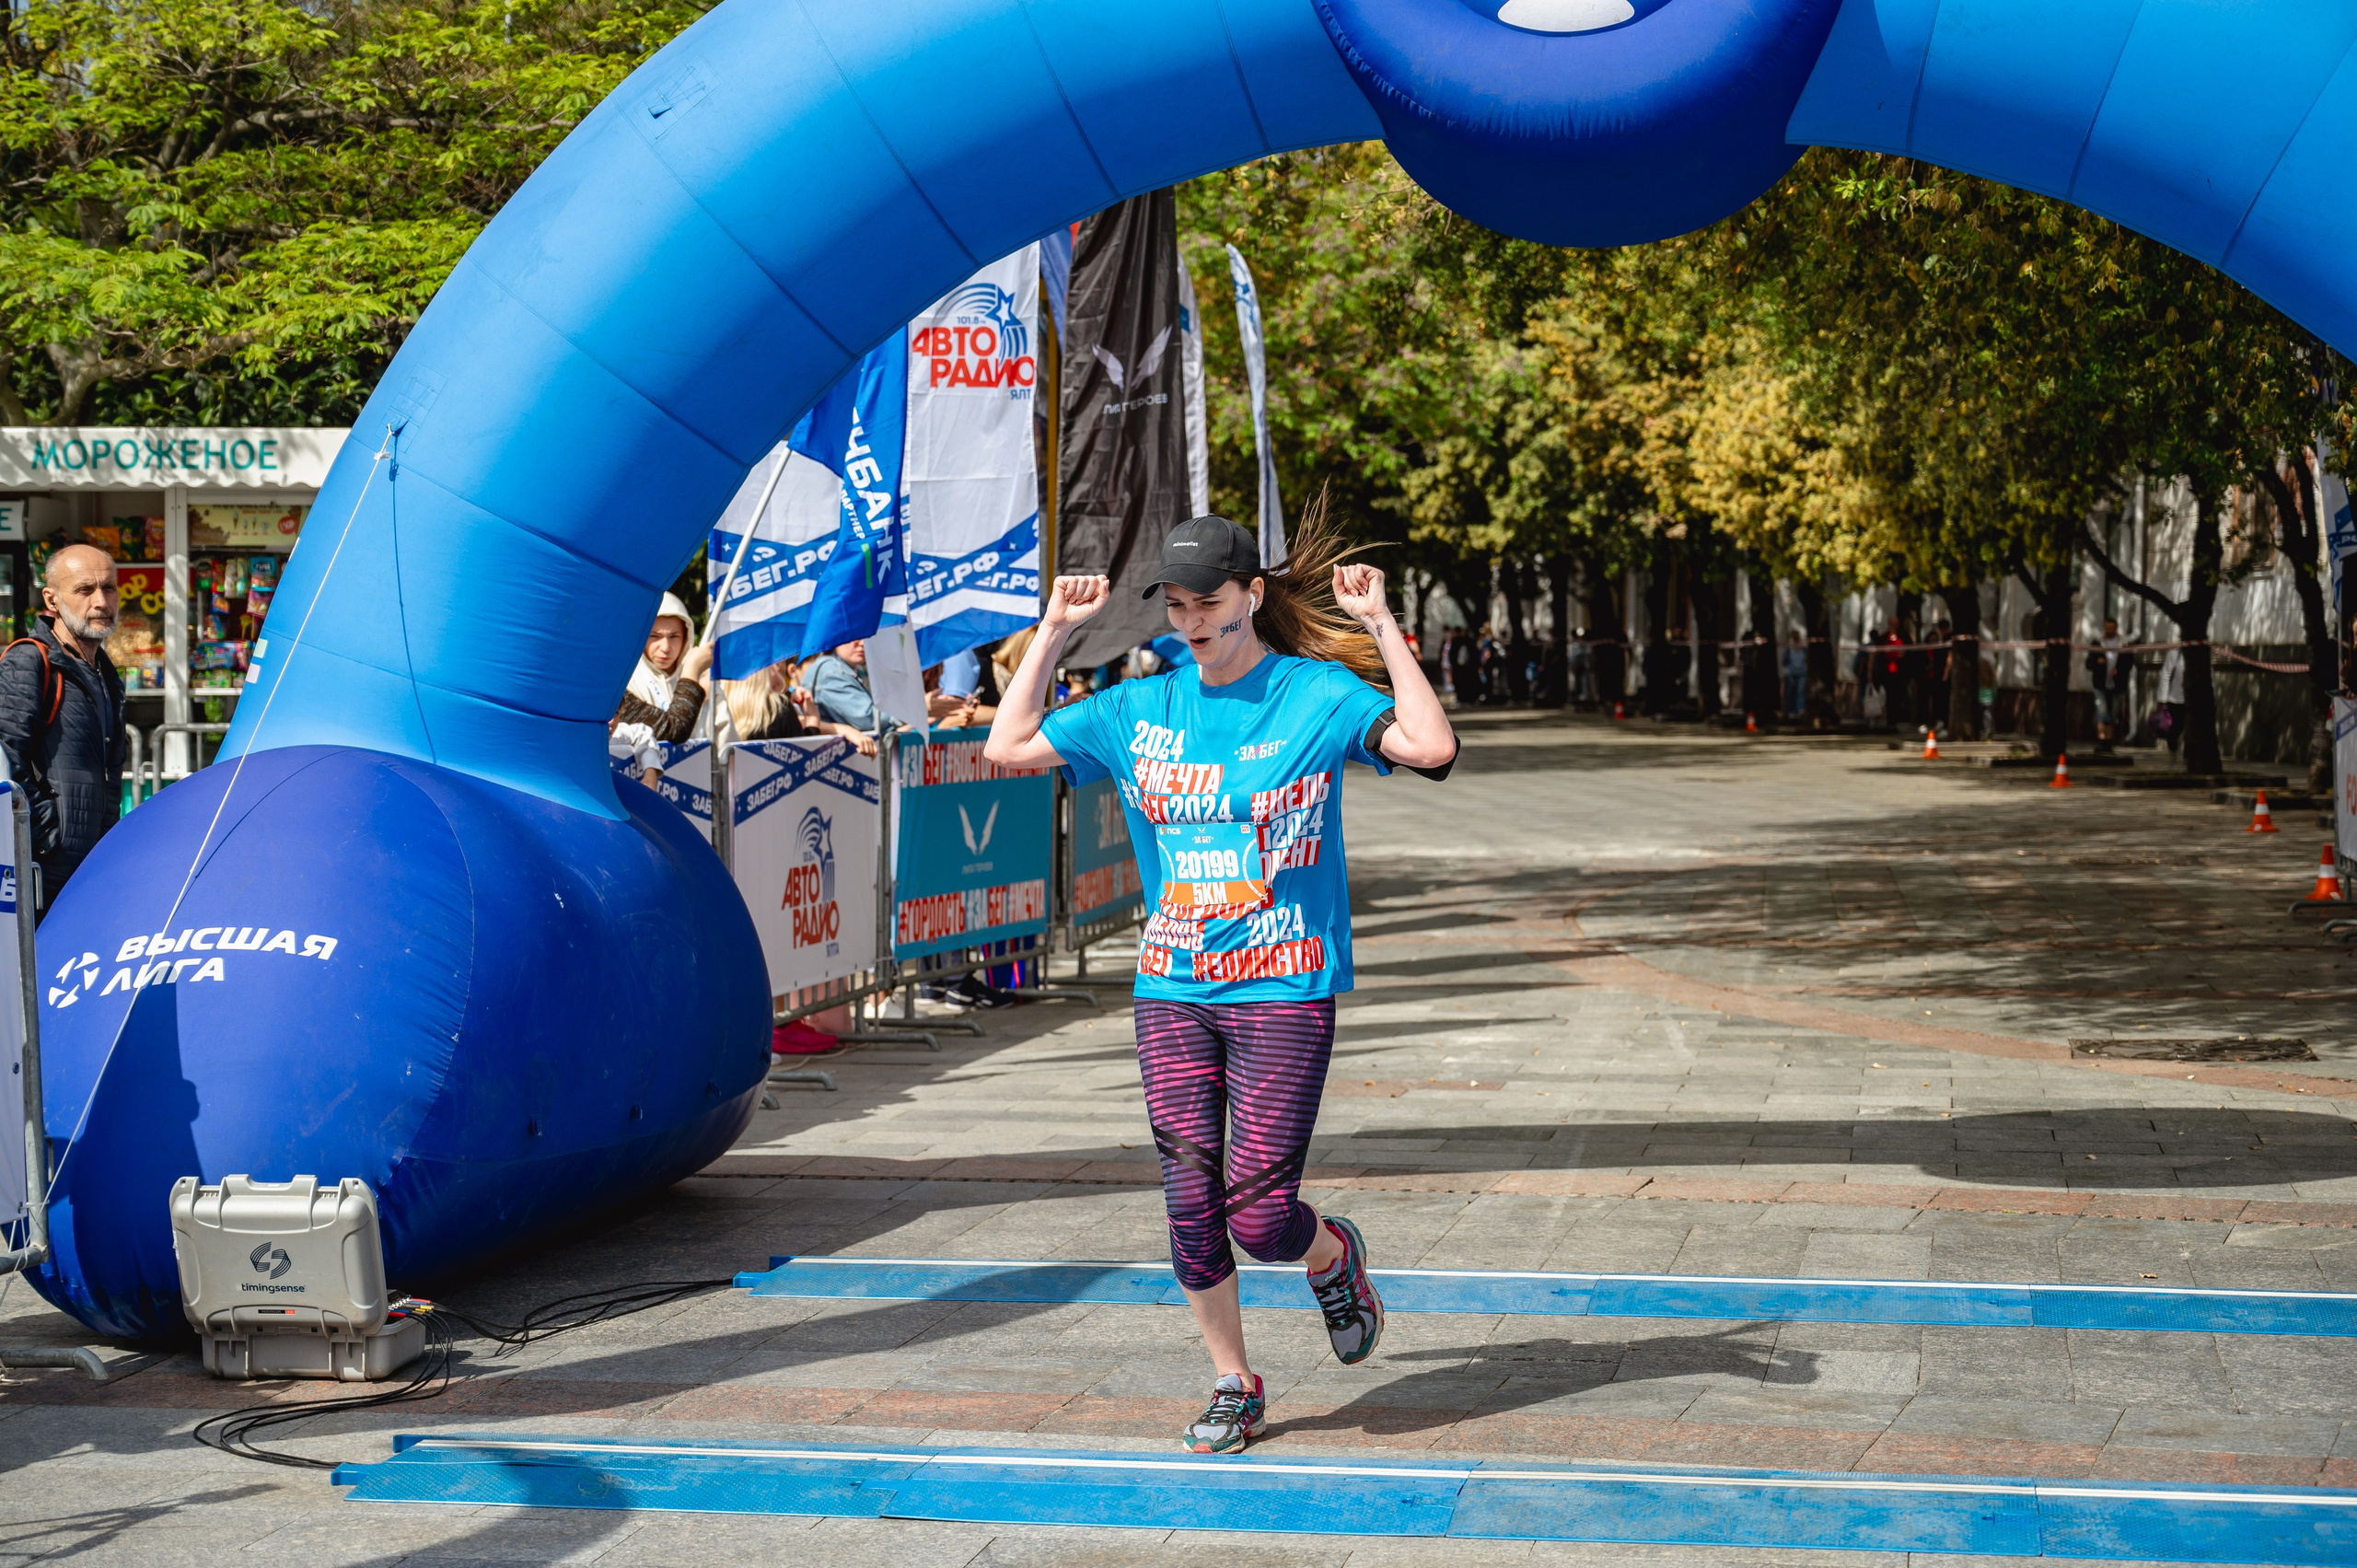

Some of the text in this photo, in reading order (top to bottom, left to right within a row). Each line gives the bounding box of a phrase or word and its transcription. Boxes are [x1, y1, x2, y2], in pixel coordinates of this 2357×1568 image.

[911, 326, 996, 356] АВТО
[930, 355, 1035, 388] РАДИО
[1010, 389, 1031, 400] ЯЛТ
[31, 439, 279, 470] МОРОЖЕНОЕ
[1129, 720, 1185, 761] 2024
[747, 772, 793, 812] ЗАБЕГ.РФ
[1133, 757, 1223, 795] #МЕЧТА
[1251, 772, 1332, 824] #ЦЕЛЬ
[1175, 849, 1239, 879] 20199
[781, 863, 820, 911] АВТО
[793, 900, 840, 949] РАДИО
[1246, 903, 1306, 947] 2024
[115, 927, 338, 961] ВЫСШАЯ
[1190, 935, 1326, 982] #ЕДИНСТВО
[99, 958, 225, 996] ЛИГА
[241, 1283, 306, 1294] timingsense
